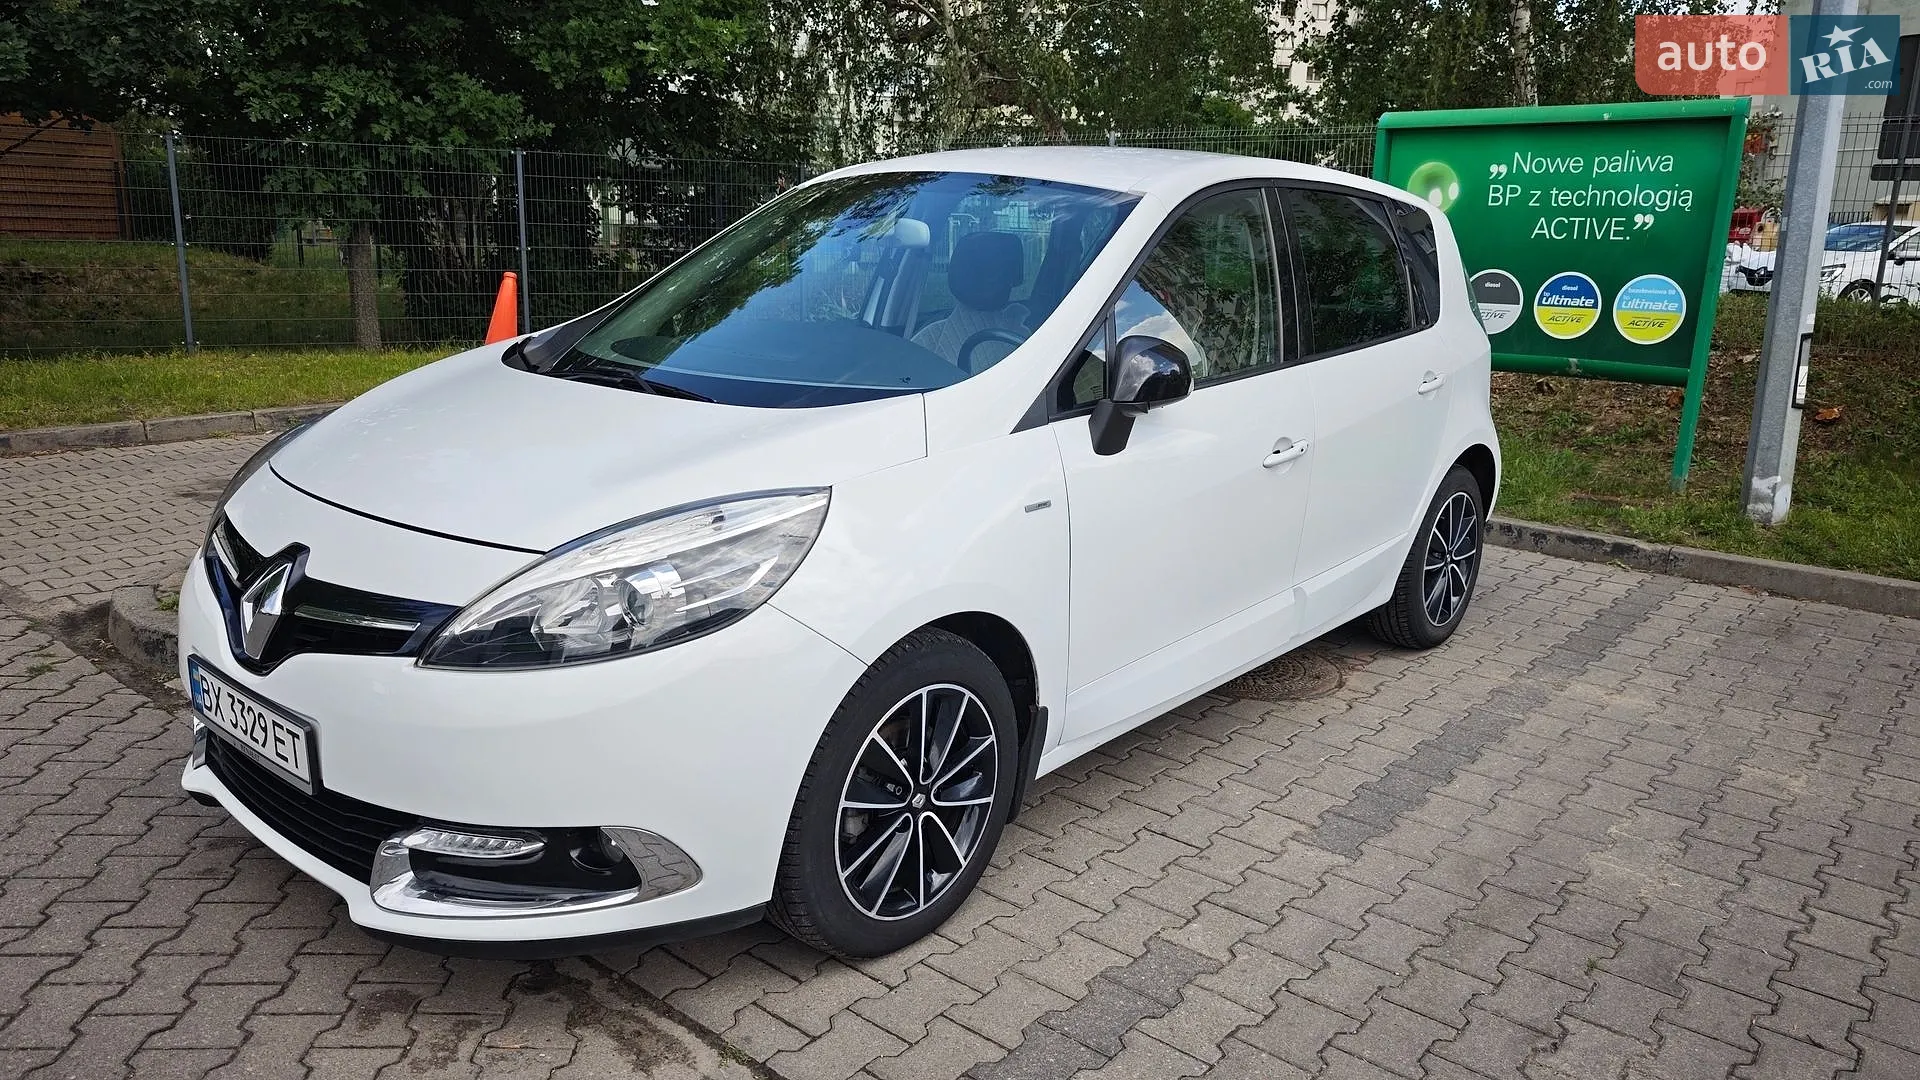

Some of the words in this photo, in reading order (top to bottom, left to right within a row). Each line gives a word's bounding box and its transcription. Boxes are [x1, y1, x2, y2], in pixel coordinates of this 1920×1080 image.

[1592, 150, 1674, 178] paliwa
[1488, 184, 1521, 206] BP
[1528, 190, 1542, 206] z
[1550, 184, 1693, 212] technologią
[1542, 294, 1595, 307] ultimate
[1621, 298, 1679, 311] ultimate
[1481, 311, 1508, 319] CTIVE
[1547, 315, 1584, 323] ACTIVE
[1627, 319, 1668, 328] ACTIVE
[200, 674, 225, 722] BX
[226, 691, 268, 748] 3329
[272, 718, 300, 769] ET
